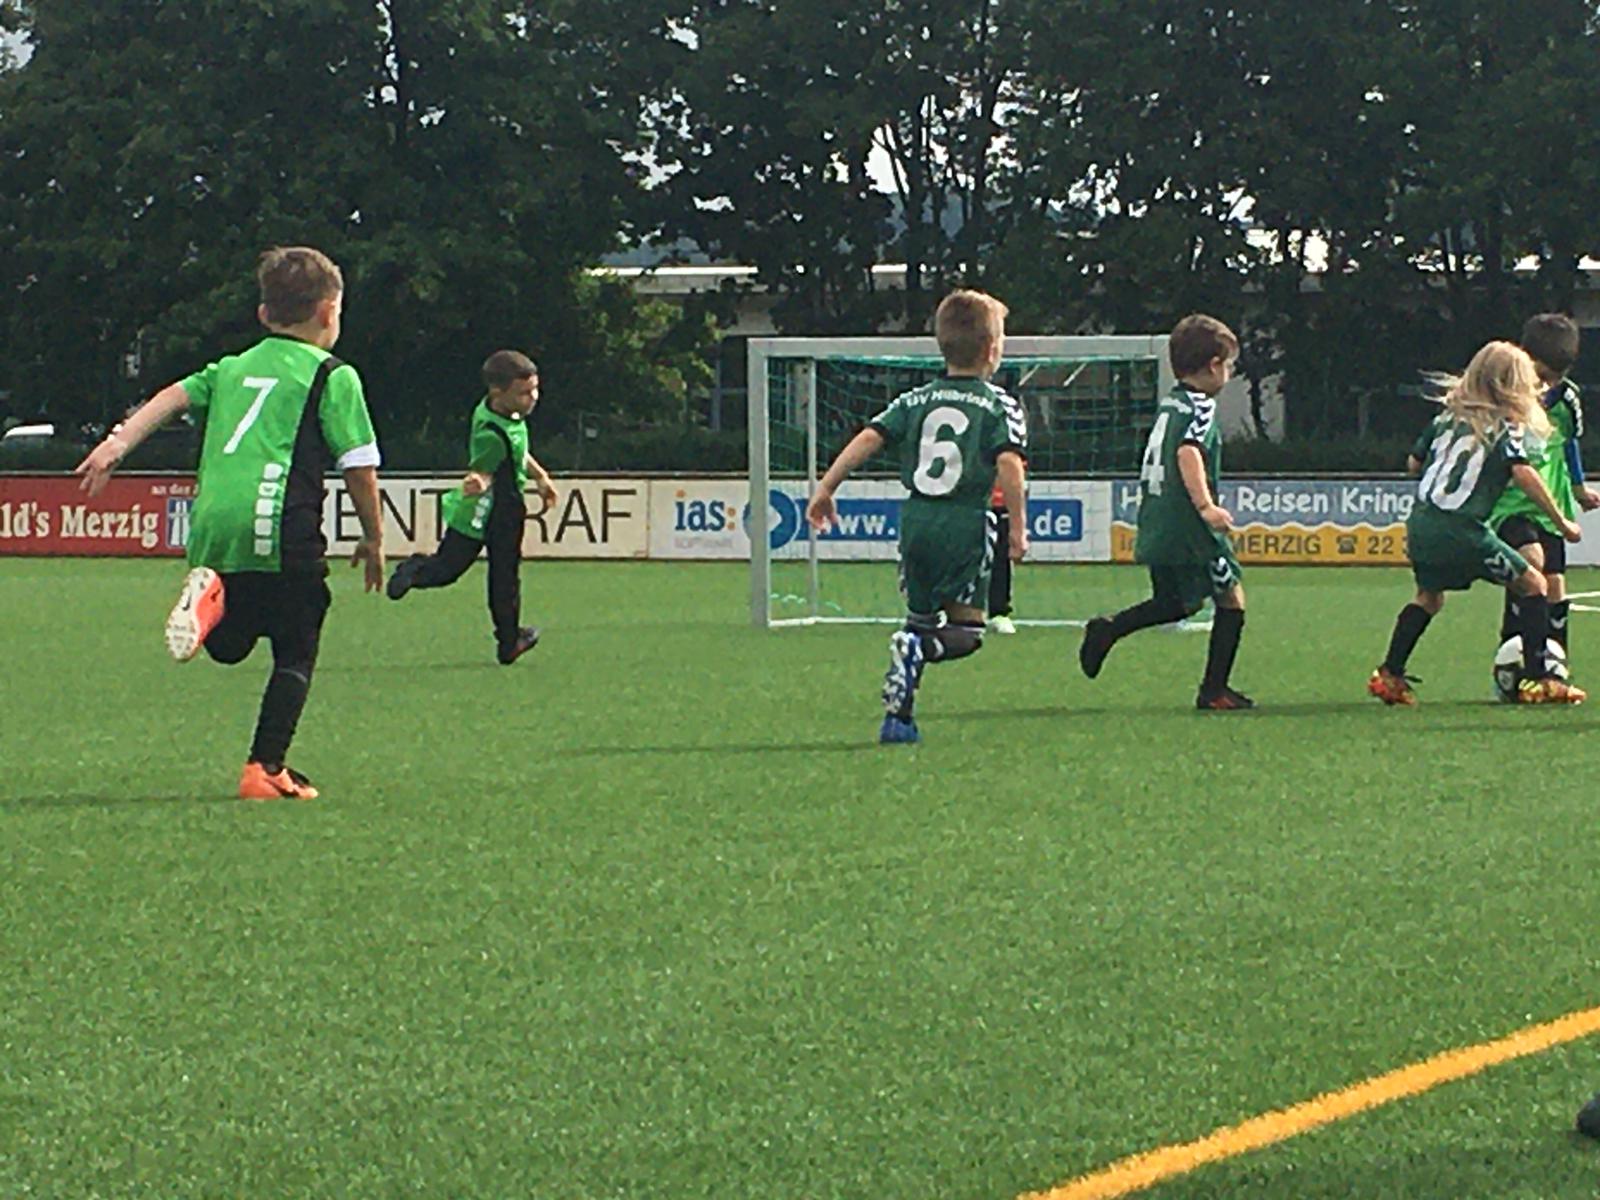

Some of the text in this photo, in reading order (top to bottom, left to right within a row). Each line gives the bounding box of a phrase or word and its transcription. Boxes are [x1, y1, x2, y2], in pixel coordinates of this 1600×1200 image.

[223, 376, 279, 454] 7
[913, 406, 970, 496] 6
[1140, 412, 1169, 496] 4
[1237, 486, 1328, 514] Reisen
[1418, 429, 1486, 511] 10
[60, 503, 159, 549] Merzig
[1367, 535, 1394, 555] 22
